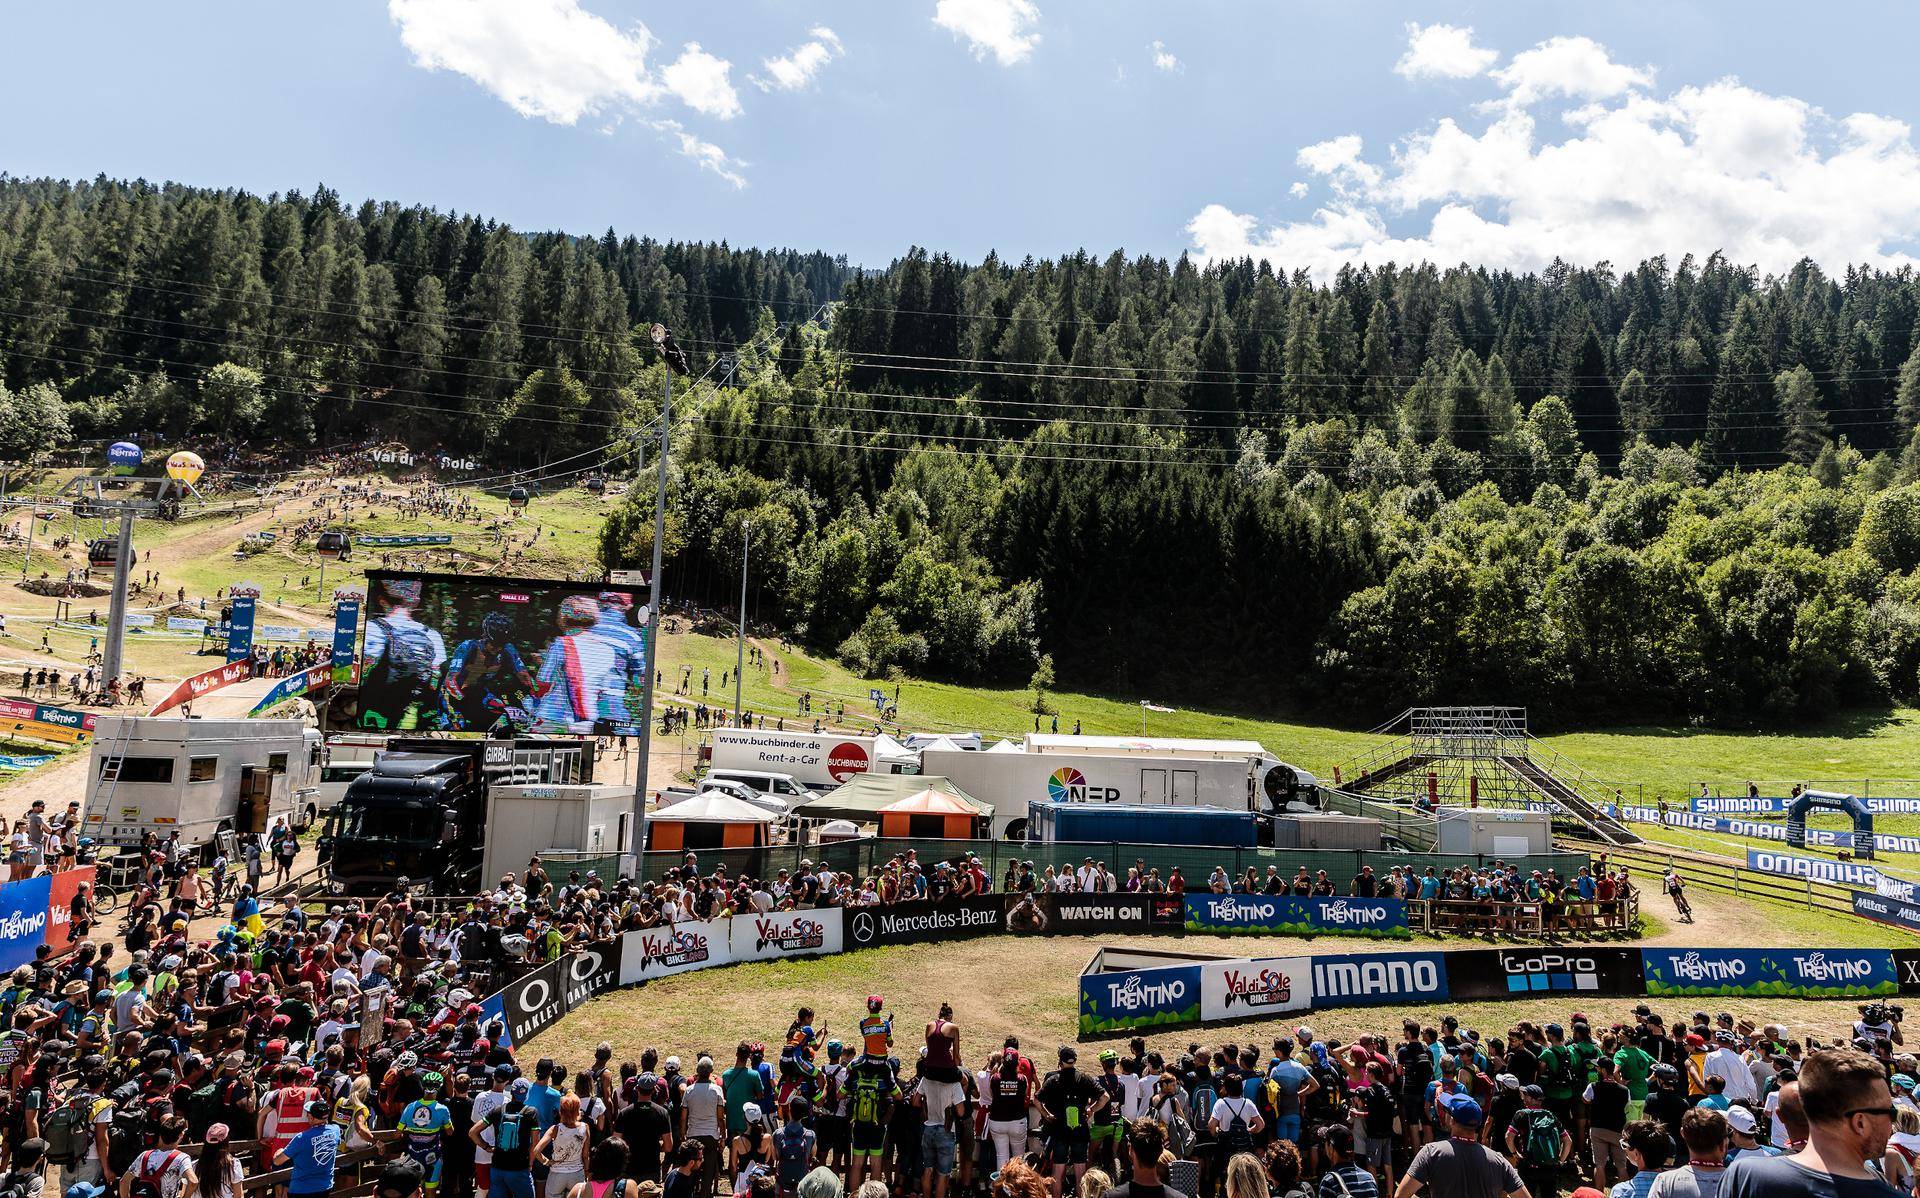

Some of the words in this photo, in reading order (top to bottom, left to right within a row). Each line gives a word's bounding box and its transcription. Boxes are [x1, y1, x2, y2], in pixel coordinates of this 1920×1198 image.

[111, 447, 139, 457] TRENTINO
[373, 450, 396, 463] Val
[441, 456, 475, 470] Sole
[42, 710, 77, 724] TRENTINO
[719, 735, 821, 750] www.buchbinder.de
[758, 751, 820, 765] Rent-a-Car
[828, 758, 868, 769] BUCHBINDER
[1070, 786, 1120, 803] NEP
[1696, 798, 1773, 812] SHIMANO
[1809, 796, 1842, 806] SHIMANO
[50, 905, 65, 927] Val
[1060, 906, 1114, 920] WATCH
[1118, 906, 1142, 920] ON
[1207, 900, 1275, 922] TRENTINO
[1318, 902, 1387, 924] TRENTINO
[1855, 897, 1888, 914] Mitas
[755, 918, 779, 940] Val
[780, 925, 792, 937] di
[792, 917, 824, 939] Sole
[880, 908, 997, 935] Mercedes-Benz
[642, 935, 662, 957] Val
[663, 942, 674, 954] di
[674, 930, 708, 953] Sole
[1503, 955, 1596, 973] GoPro
[1668, 954, 1746, 981] TRENTINO
[1793, 954, 1872, 981] TRENTINO
[567, 971, 614, 1005] OAKLEY
[1224, 970, 1247, 994] Val
[1248, 977, 1259, 992] di
[1260, 968, 1291, 990] Sole
[1108, 979, 1185, 1010] TRENTINO
[515, 1001, 560, 1039] OAKLEY
